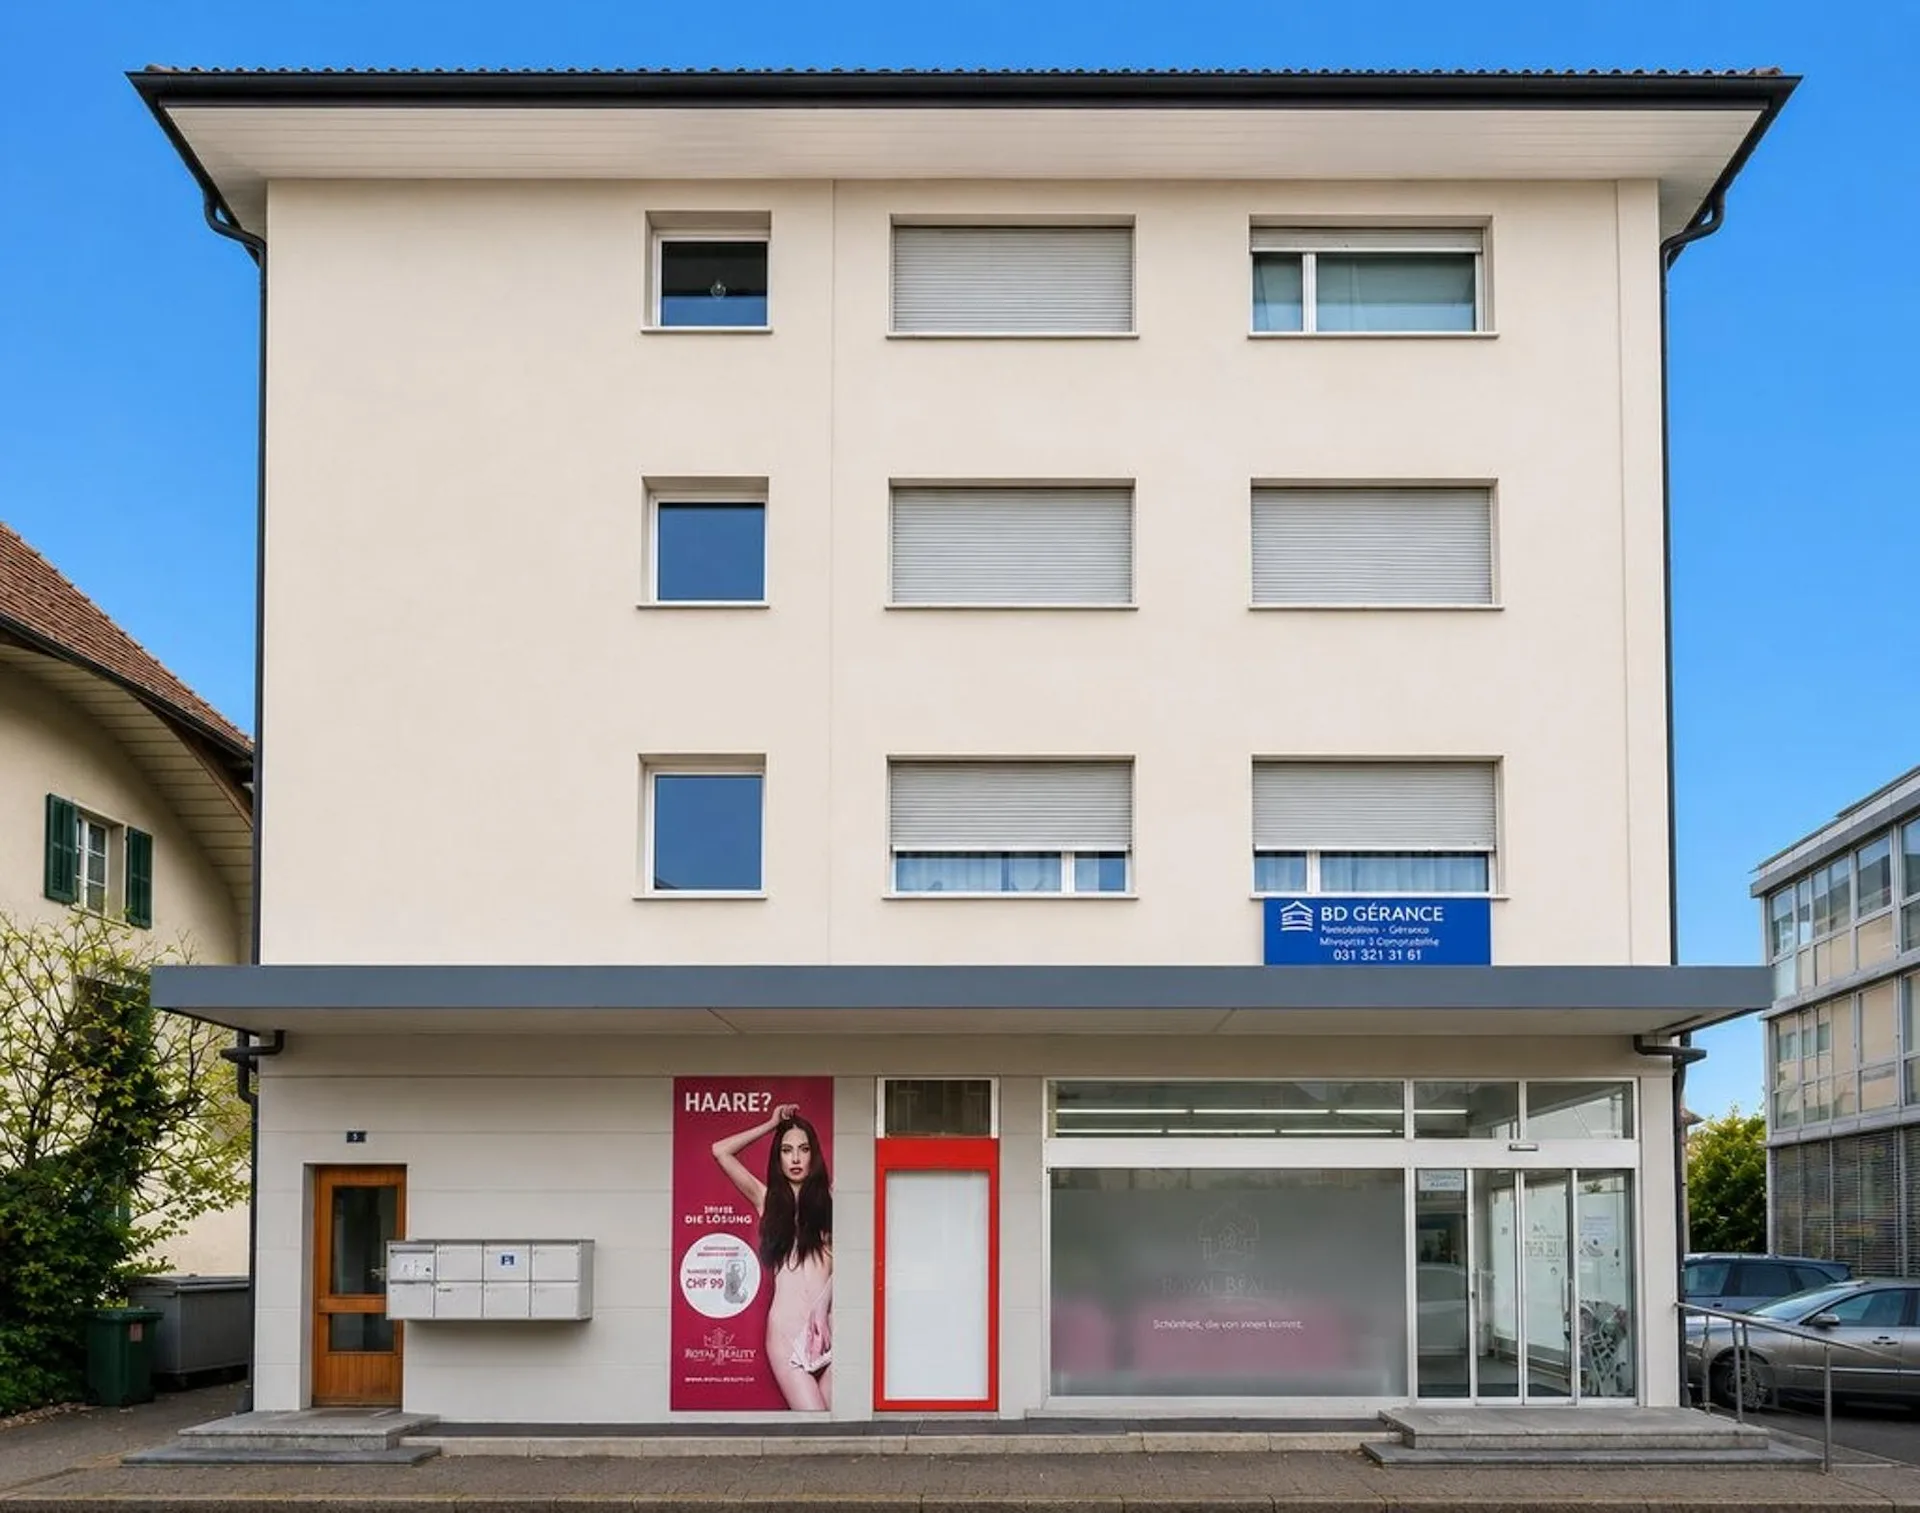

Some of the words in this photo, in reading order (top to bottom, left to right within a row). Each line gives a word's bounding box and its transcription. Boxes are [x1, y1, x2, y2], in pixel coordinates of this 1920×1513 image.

[1320, 906, 1348, 922] BD
[1352, 902, 1444, 922] GÉRANCE
[1333, 948, 1357, 961] 031
[1360, 948, 1383, 961] 321
[1388, 948, 1402, 961] 31
[1407, 948, 1422, 961] 61
[685, 1092, 772, 1112] HAARE?
[710, 1278, 724, 1289] 99
